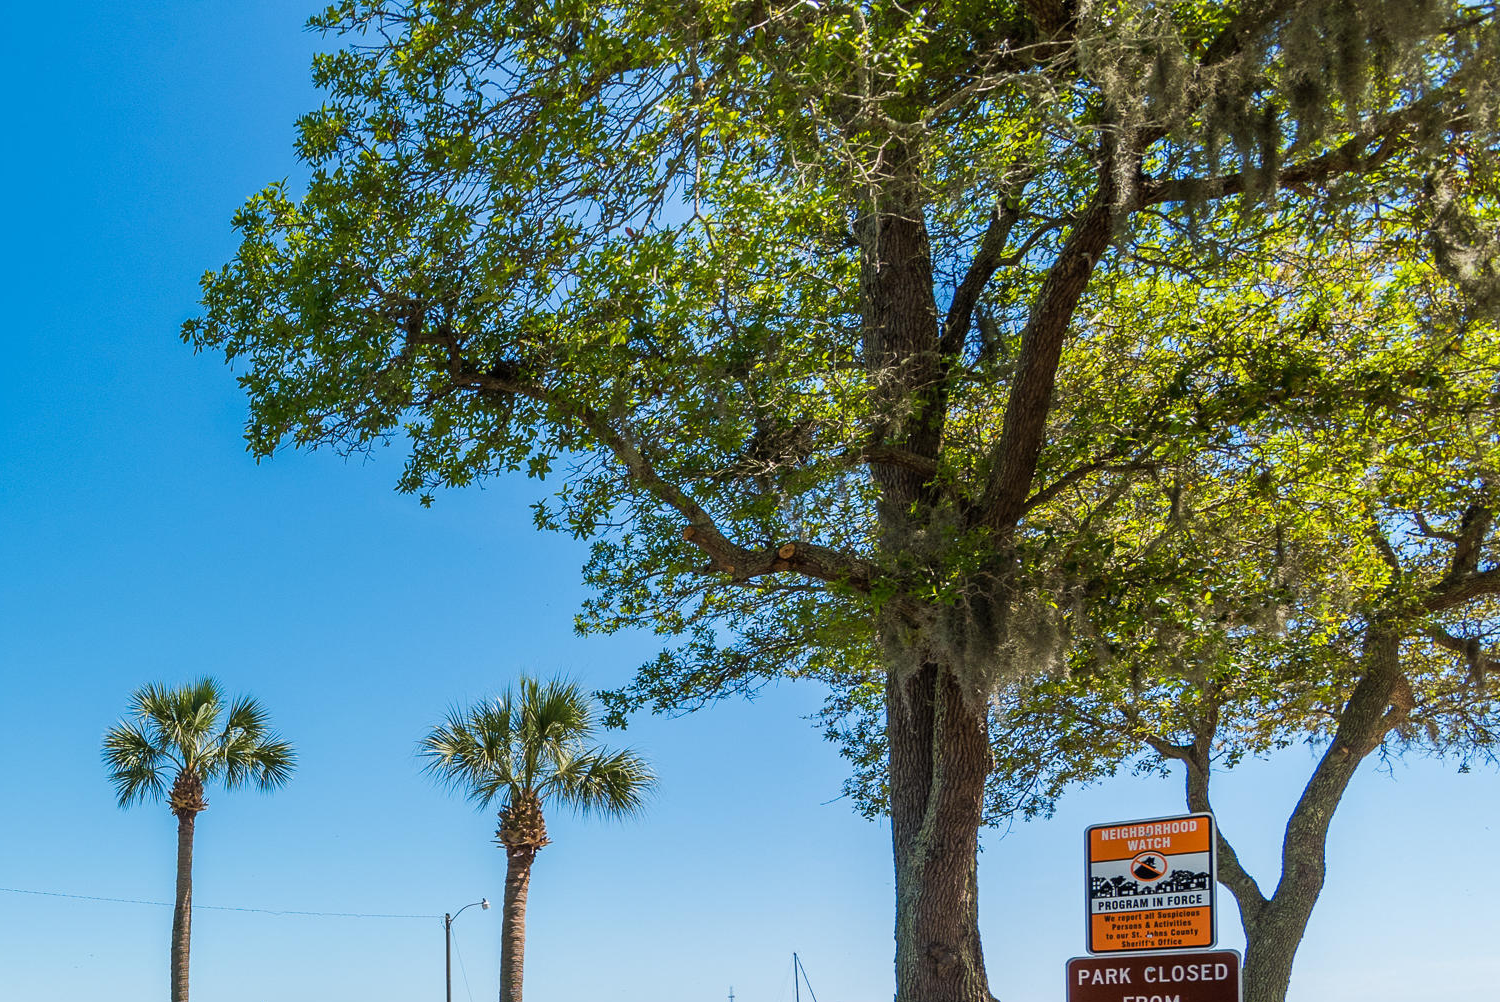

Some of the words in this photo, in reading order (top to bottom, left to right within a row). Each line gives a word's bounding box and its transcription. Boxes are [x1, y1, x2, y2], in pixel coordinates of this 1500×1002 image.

[1101, 821, 1197, 841] NEIGHBORHOOD
[1128, 837, 1171, 851] WATCH
[1099, 899, 1149, 911] PROGRAM
[1153, 898, 1163, 907] IN
[1168, 895, 1202, 906] FORCE
[1118, 913, 1142, 923] report
[1158, 910, 1200, 920] Suspicious
[1112, 922, 1142, 930] Persons
[1154, 919, 1192, 928] Activities
[1171, 928, 1198, 938] County
[1122, 940, 1155, 948] Sheriff's
[1158, 938, 1182, 946] Office
[1078, 968, 1131, 985] PARK
[1144, 964, 1228, 983] CLOSED
